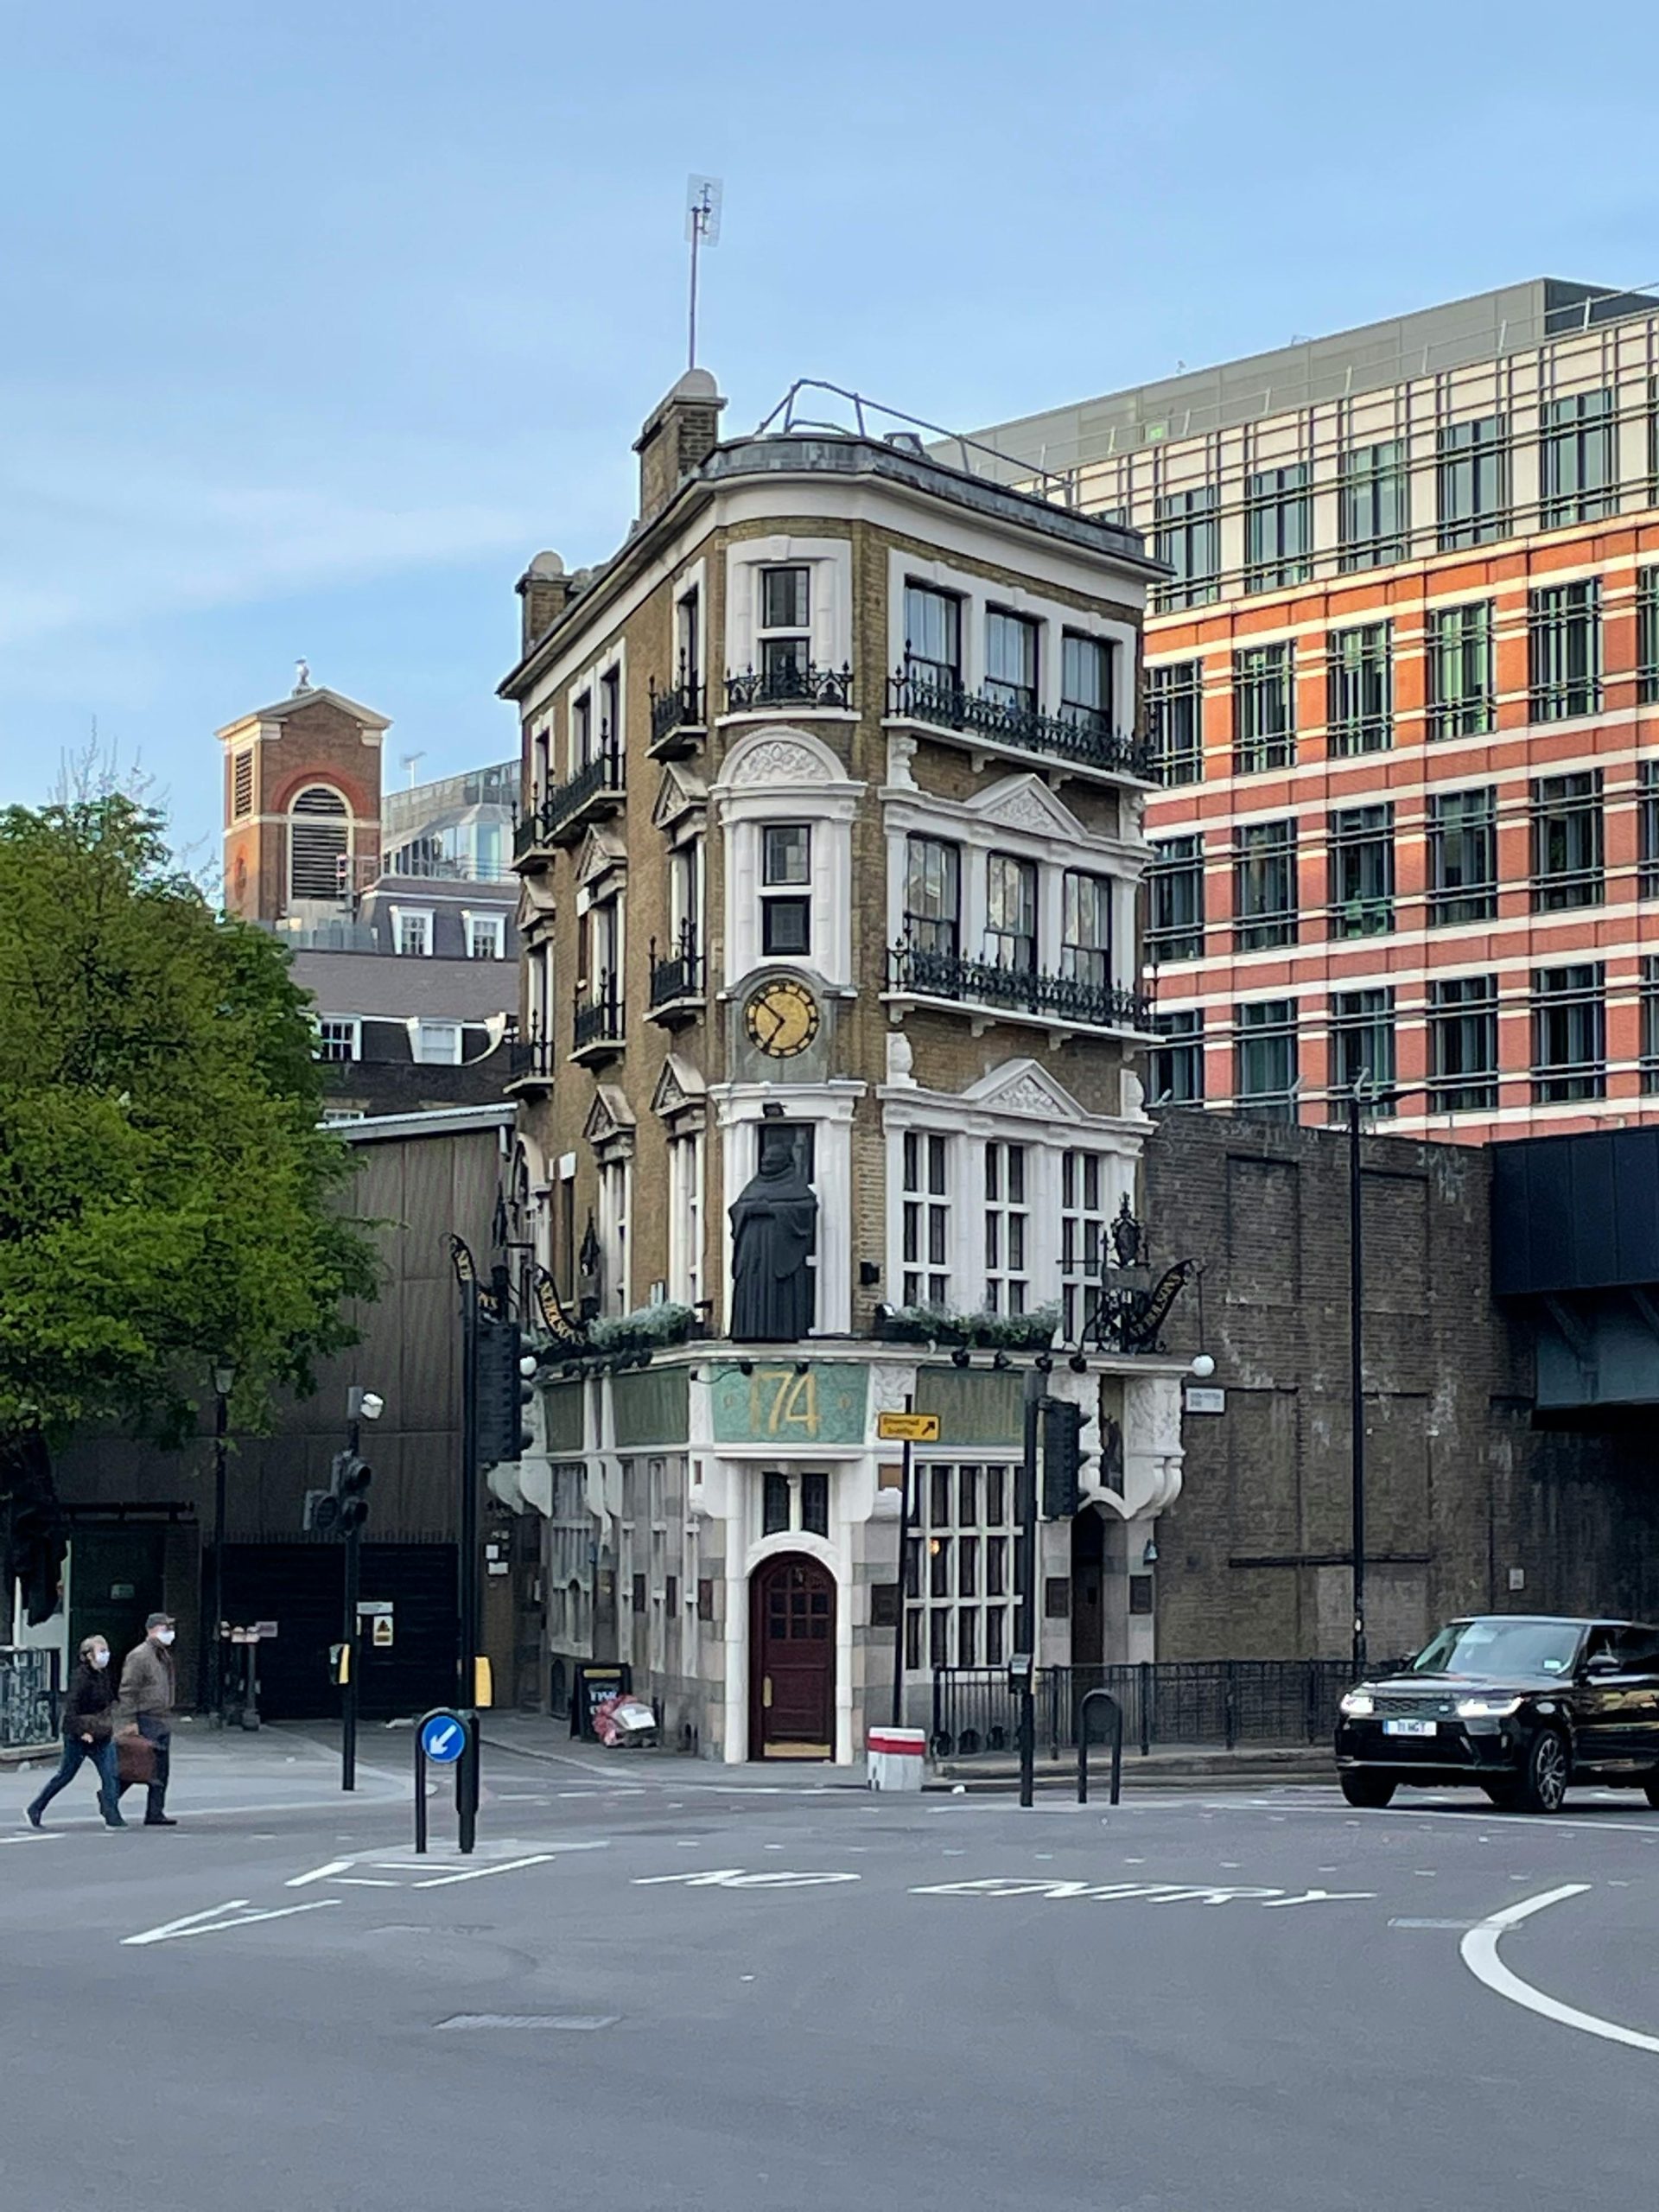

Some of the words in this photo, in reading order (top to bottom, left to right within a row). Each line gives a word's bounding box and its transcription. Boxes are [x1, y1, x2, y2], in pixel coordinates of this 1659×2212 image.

[748, 1370, 822, 1439] 174
[630, 1869, 862, 1889] NO
[907, 1878, 1378, 1906] ENTRY
